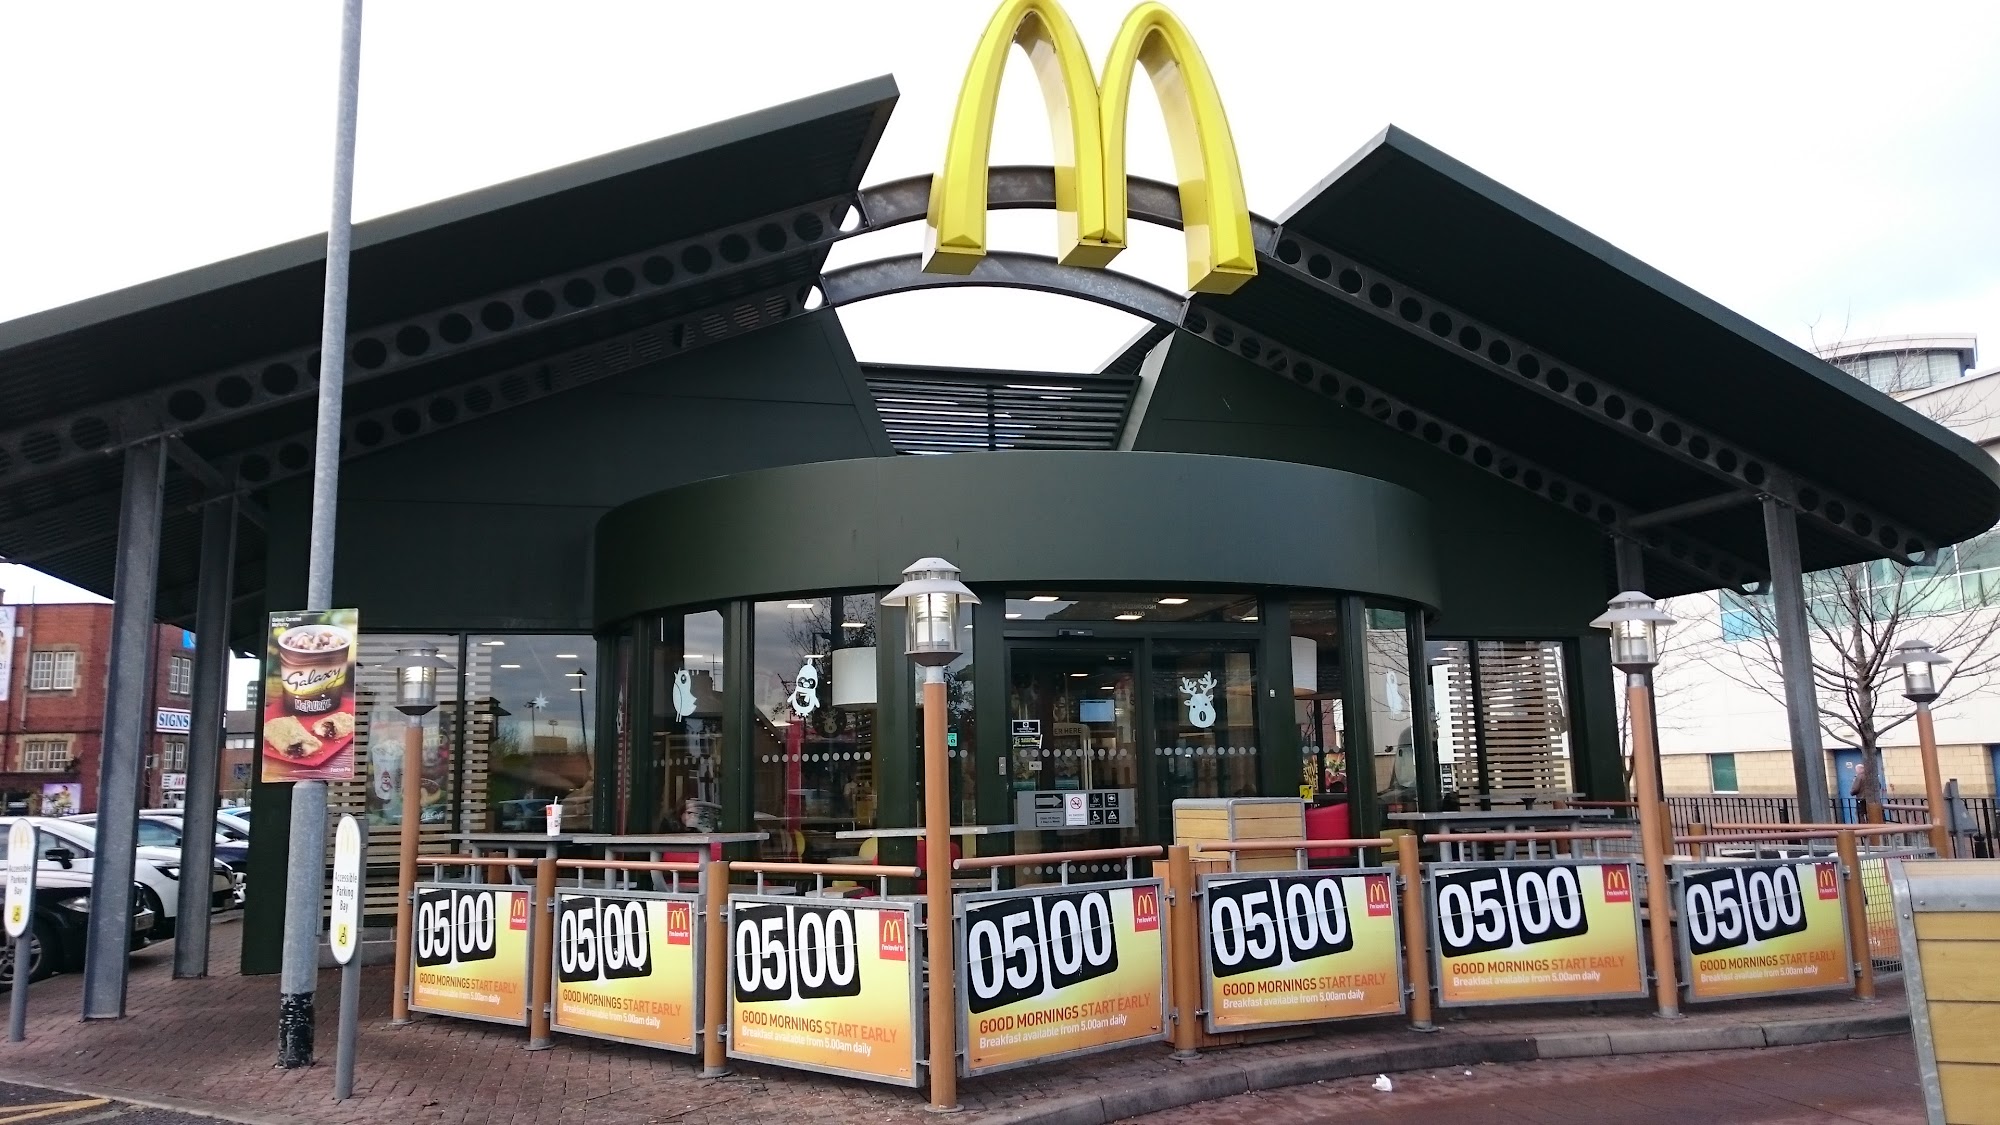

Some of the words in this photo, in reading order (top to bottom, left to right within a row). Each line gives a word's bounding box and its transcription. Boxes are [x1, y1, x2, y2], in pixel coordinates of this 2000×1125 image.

[283, 668, 344, 691] Galaxy
[158, 712, 189, 728] SIGNS
[10, 875, 28, 885] Parking
[335, 871, 358, 883] Accessible
[336, 885, 354, 900] Parking
[339, 900, 349, 913] Bay
[1452, 962, 1485, 975] GOOD
[1487, 959, 1550, 973] MORNINGS
[1551, 957, 1587, 970] START
[1589, 955, 1625, 968] EARLY
[1700, 958, 1727, 972] GOOD
[1728, 955, 1778, 970] MORNINGS
[1779, 952, 1808, 966] START
[1809, 950, 1837, 963] EARLY
[419, 972, 436, 985] GOOD
[436, 974, 471, 989] MORNINGS
[471, 979, 493, 991] START
[494, 981, 518, 994] EARLY
[1453, 975, 1493, 987] Breakfast
[1494, 973, 1530, 986] available
[1531, 972, 1551, 983] from
[1552, 971, 1581, 983] 5.00am
[1582, 970, 1600, 982] daily
[1700, 971, 1734, 983] Breakfast
[1734, 968, 1763, 981] available
[1763, 967, 1780, 978] from
[1780, 966, 1803, 978] 5.00am
[1804, 965, 1819, 976] daily
[1223, 982, 1255, 996] GOOD
[1257, 978, 1317, 994] MORNINGS
[1318, 975, 1352, 990] START
[1354, 972, 1387, 987] EARLY
[488, 994, 500, 1005] daily
[563, 988, 582, 1002] GOOD
[582, 991, 622, 1009] MORNINGS
[623, 998, 650, 1014] START
[652, 1001, 682, 1017] EARLY
[1223, 994, 1263, 1009] Breakfast
[1263, 992, 1298, 1006] available
[1299, 991, 1318, 1003] from
[1319, 990, 1347, 1002] 5.00am
[1347, 990, 1365, 1001] daily
[609, 1011, 623, 1022] from
[623, 1012, 645, 1026] 5.00am
[645, 1014, 661, 1029] daily
[979, 1015, 1014, 1035] GOOD
[1016, 1005, 1079, 1029] MORNINGS
[1081, 998, 1115, 1018] START
[1117, 992, 1151, 1011] EARLY
[742, 1009, 768, 1026] GOOD
[769, 1013, 823, 1034] MORNINGS
[824, 1021, 858, 1039] START
[861, 1025, 897, 1043] EARLY
[979, 1032, 1022, 1049] Breakfast
[1022, 1025, 1059, 1041] available
[1060, 1021, 1080, 1035] from
[1081, 1018, 1109, 1031] 5.00am
[1109, 1014, 1128, 1027] daily
[741, 1026, 774, 1041] Breakfast
[774, 1032, 806, 1046] available
[806, 1035, 824, 1048] from
[825, 1036, 852, 1052] 5.00am
[853, 1040, 872, 1057] daily
